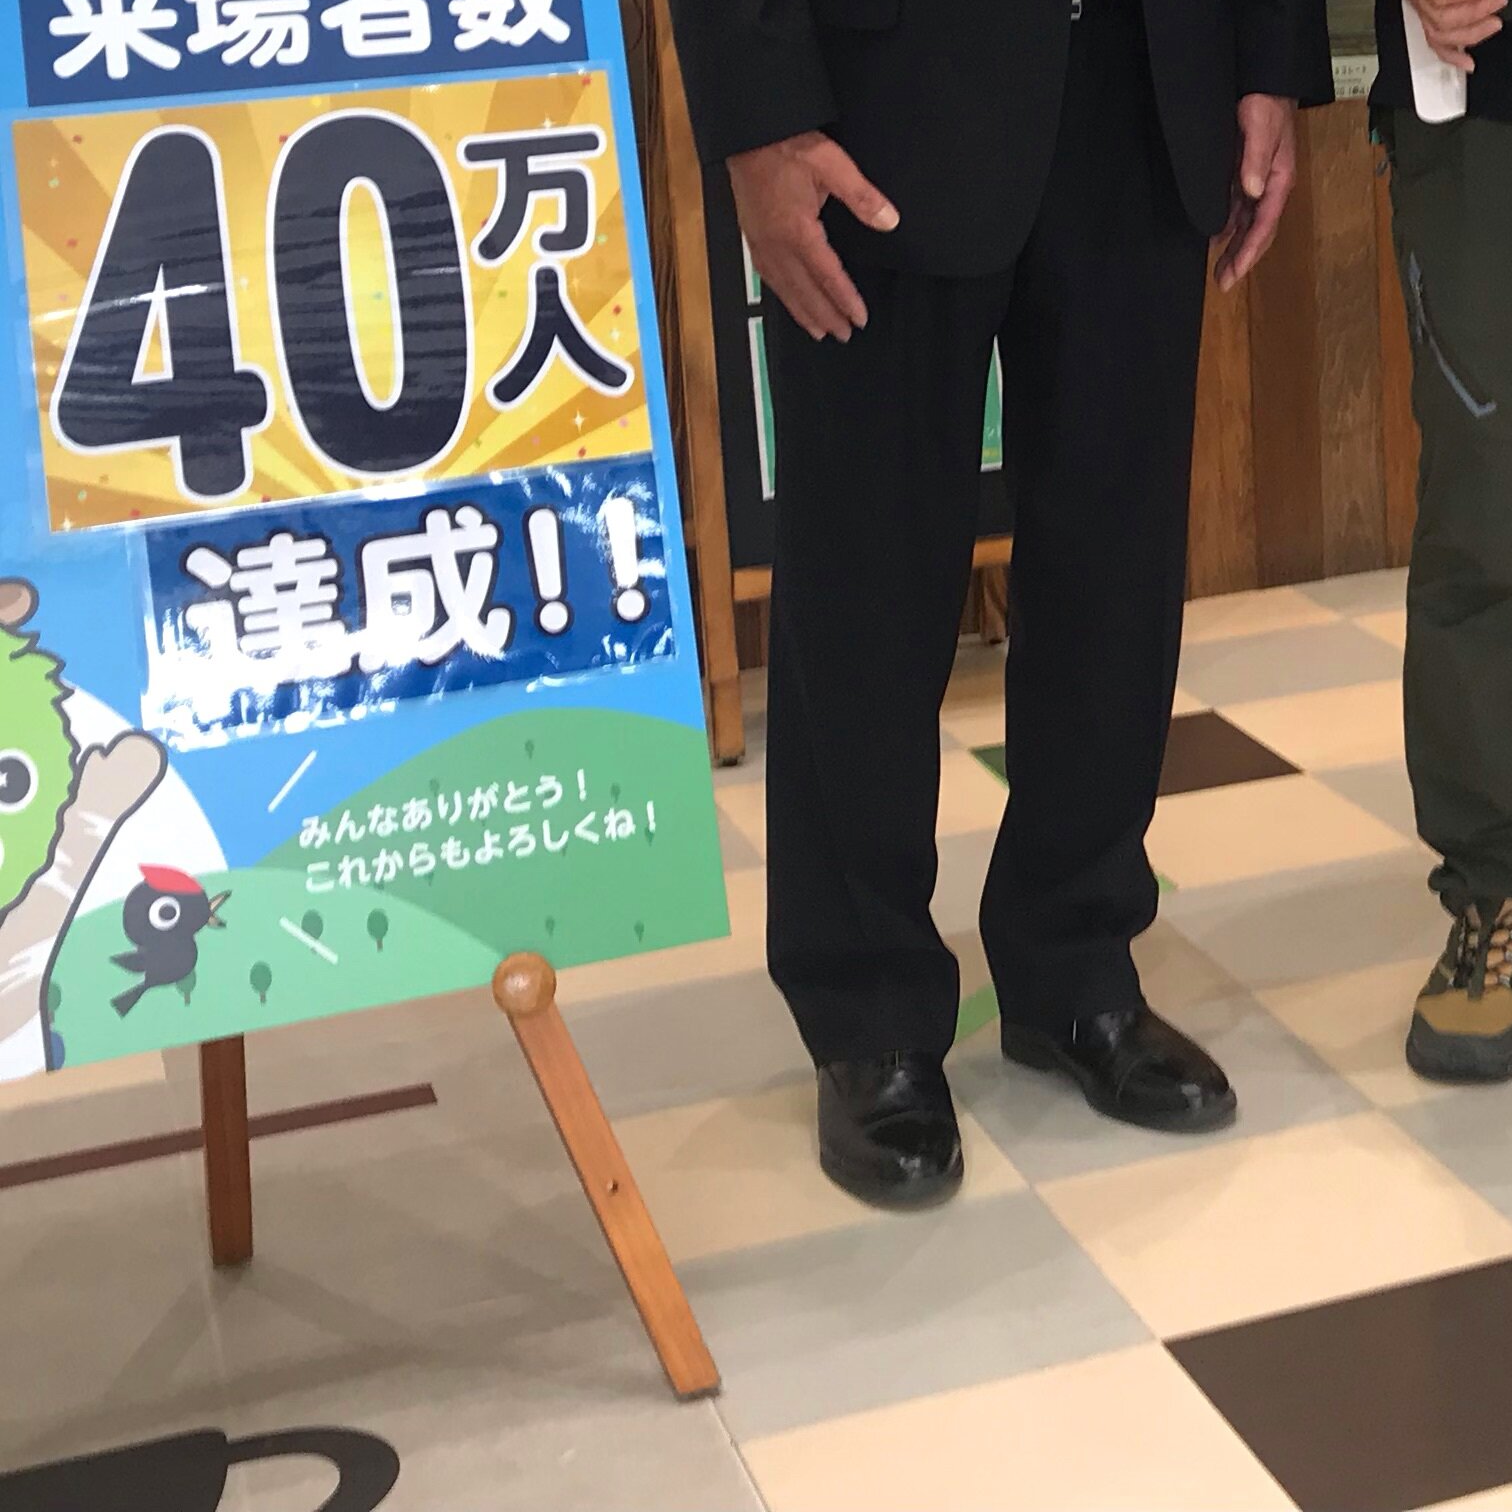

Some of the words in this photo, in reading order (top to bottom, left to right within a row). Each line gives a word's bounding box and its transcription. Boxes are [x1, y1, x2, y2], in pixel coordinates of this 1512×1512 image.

[299, 768, 588, 849] みんなありがとう！
[305, 800, 656, 893] これからもよろしくね！
